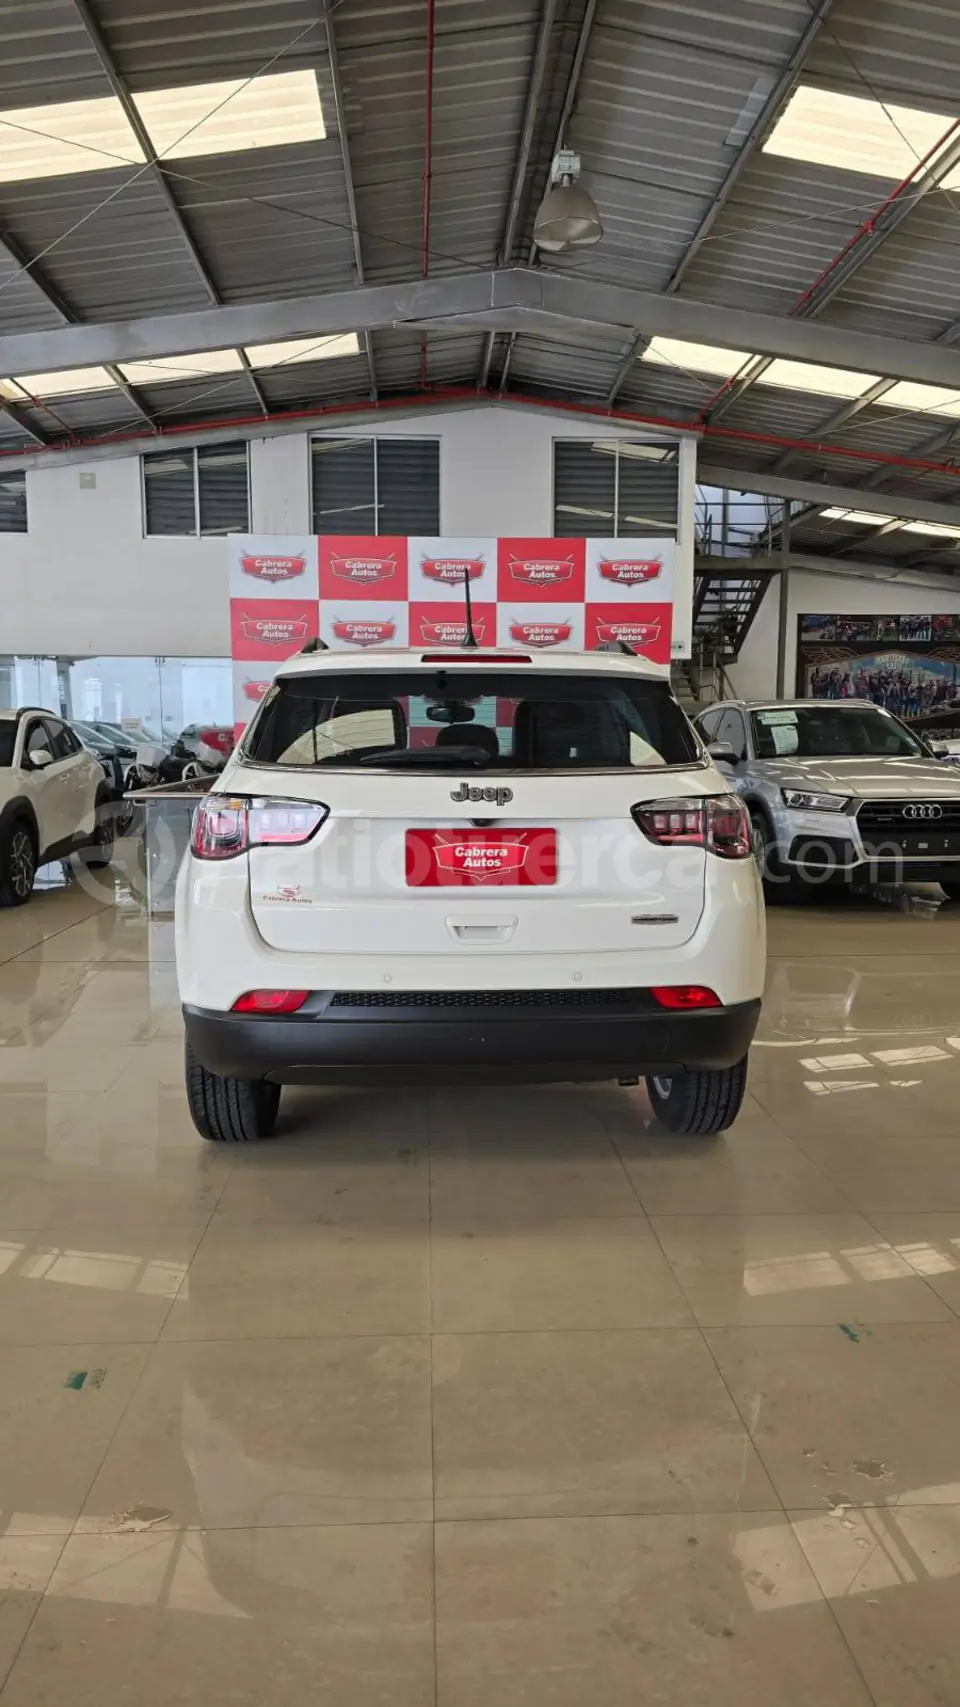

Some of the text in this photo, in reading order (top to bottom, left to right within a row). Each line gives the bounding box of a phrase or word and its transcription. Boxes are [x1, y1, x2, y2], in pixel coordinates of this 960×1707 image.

[255, 559, 292, 568] Cabrera
[344, 561, 381, 569] Cabrera
[523, 563, 560, 571] Cabrera
[612, 563, 648, 571] Cabrera
[260, 567, 288, 575] Autos
[351, 568, 377, 576] Autos
[256, 622, 293, 630] Cabrera
[346, 624, 382, 632] Cabrera
[435, 625, 466, 633] Cabrer
[523, 626, 558, 634] Cabrera
[611, 626, 647, 634] Cabrera
[617, 633, 642, 641] Autos
[450, 782, 514, 807] Jeep
[455, 846, 508, 857] Cabrera
[463, 857, 502, 868] Autos
